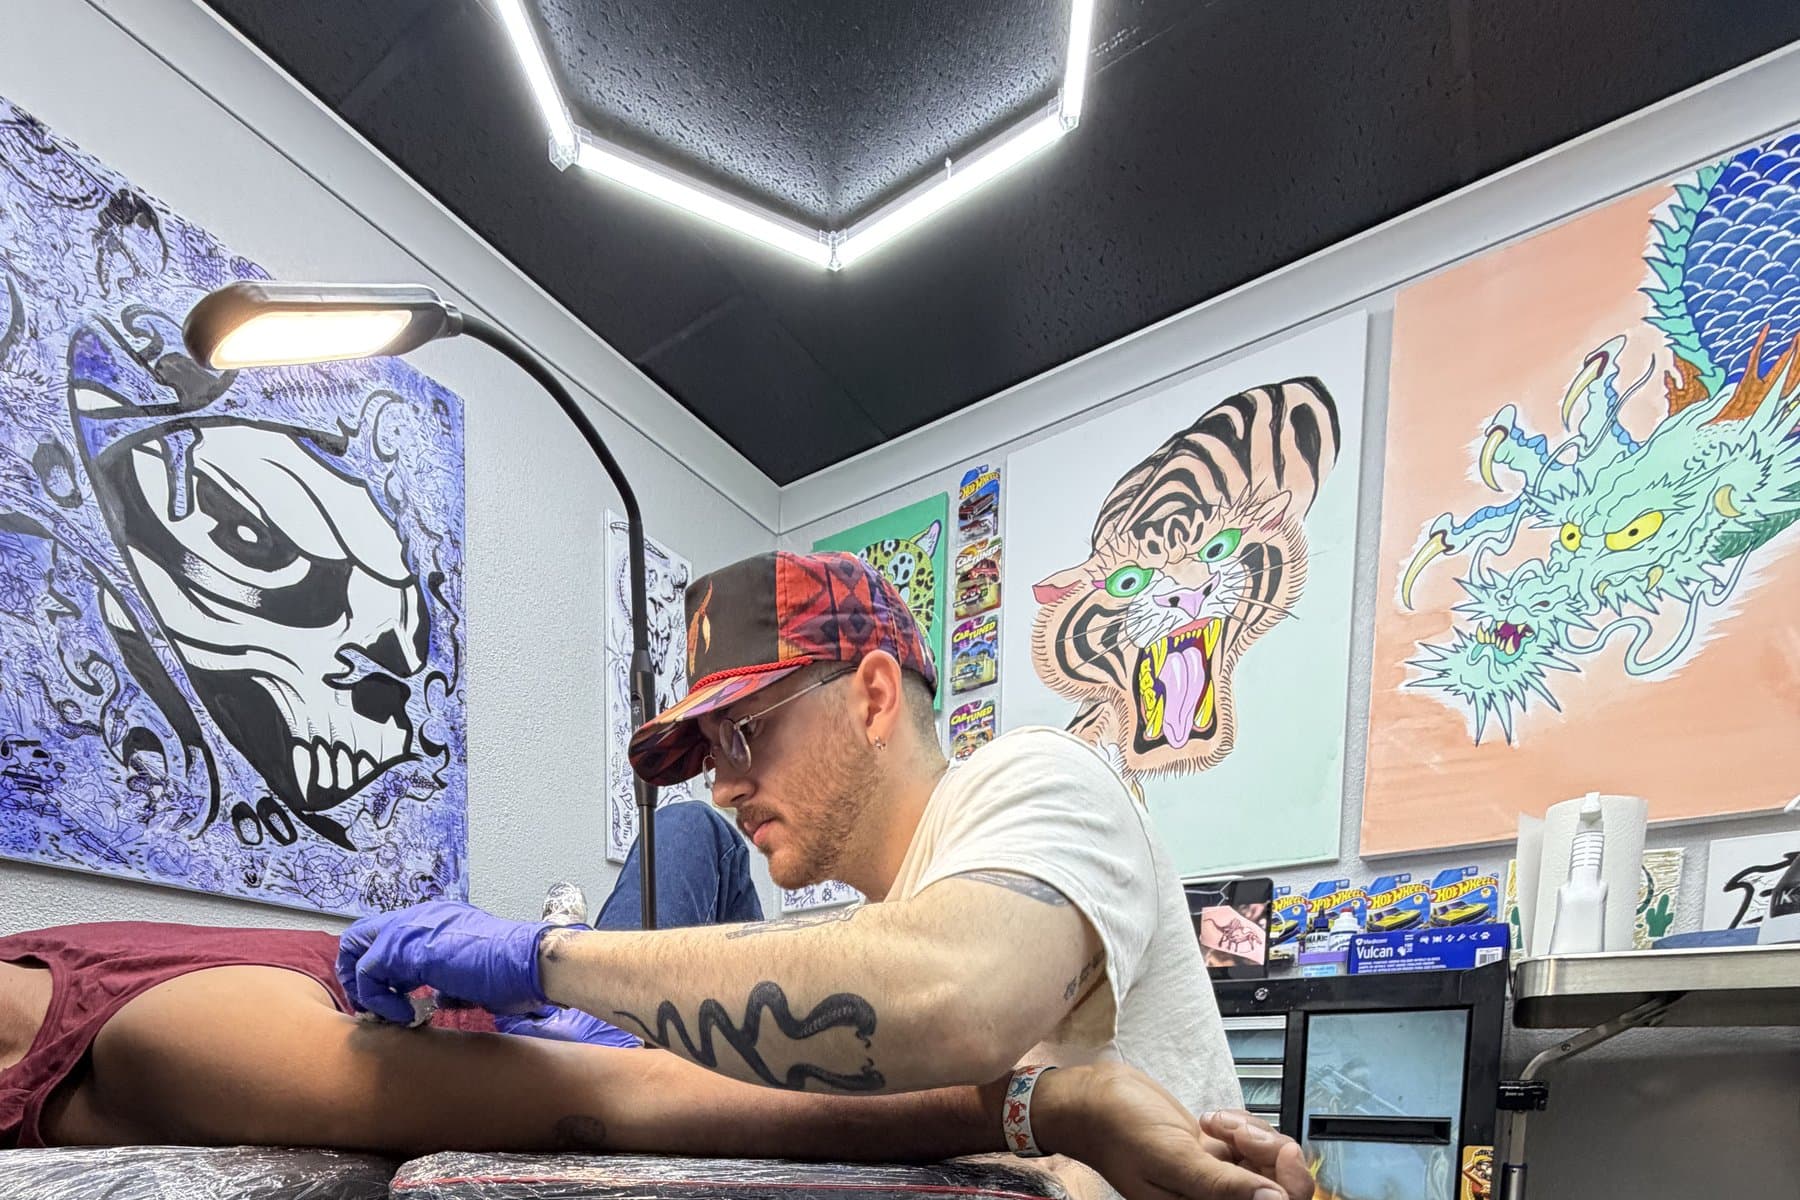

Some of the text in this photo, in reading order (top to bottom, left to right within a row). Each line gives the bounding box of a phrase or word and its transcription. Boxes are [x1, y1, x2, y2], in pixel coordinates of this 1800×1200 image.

[1331, 889, 1366, 904] WHEELS
[1371, 884, 1429, 909] HOT WHEELS
[1435, 877, 1496, 902] HOT WHEELS
[1356, 945, 1394, 960] Vulcan
